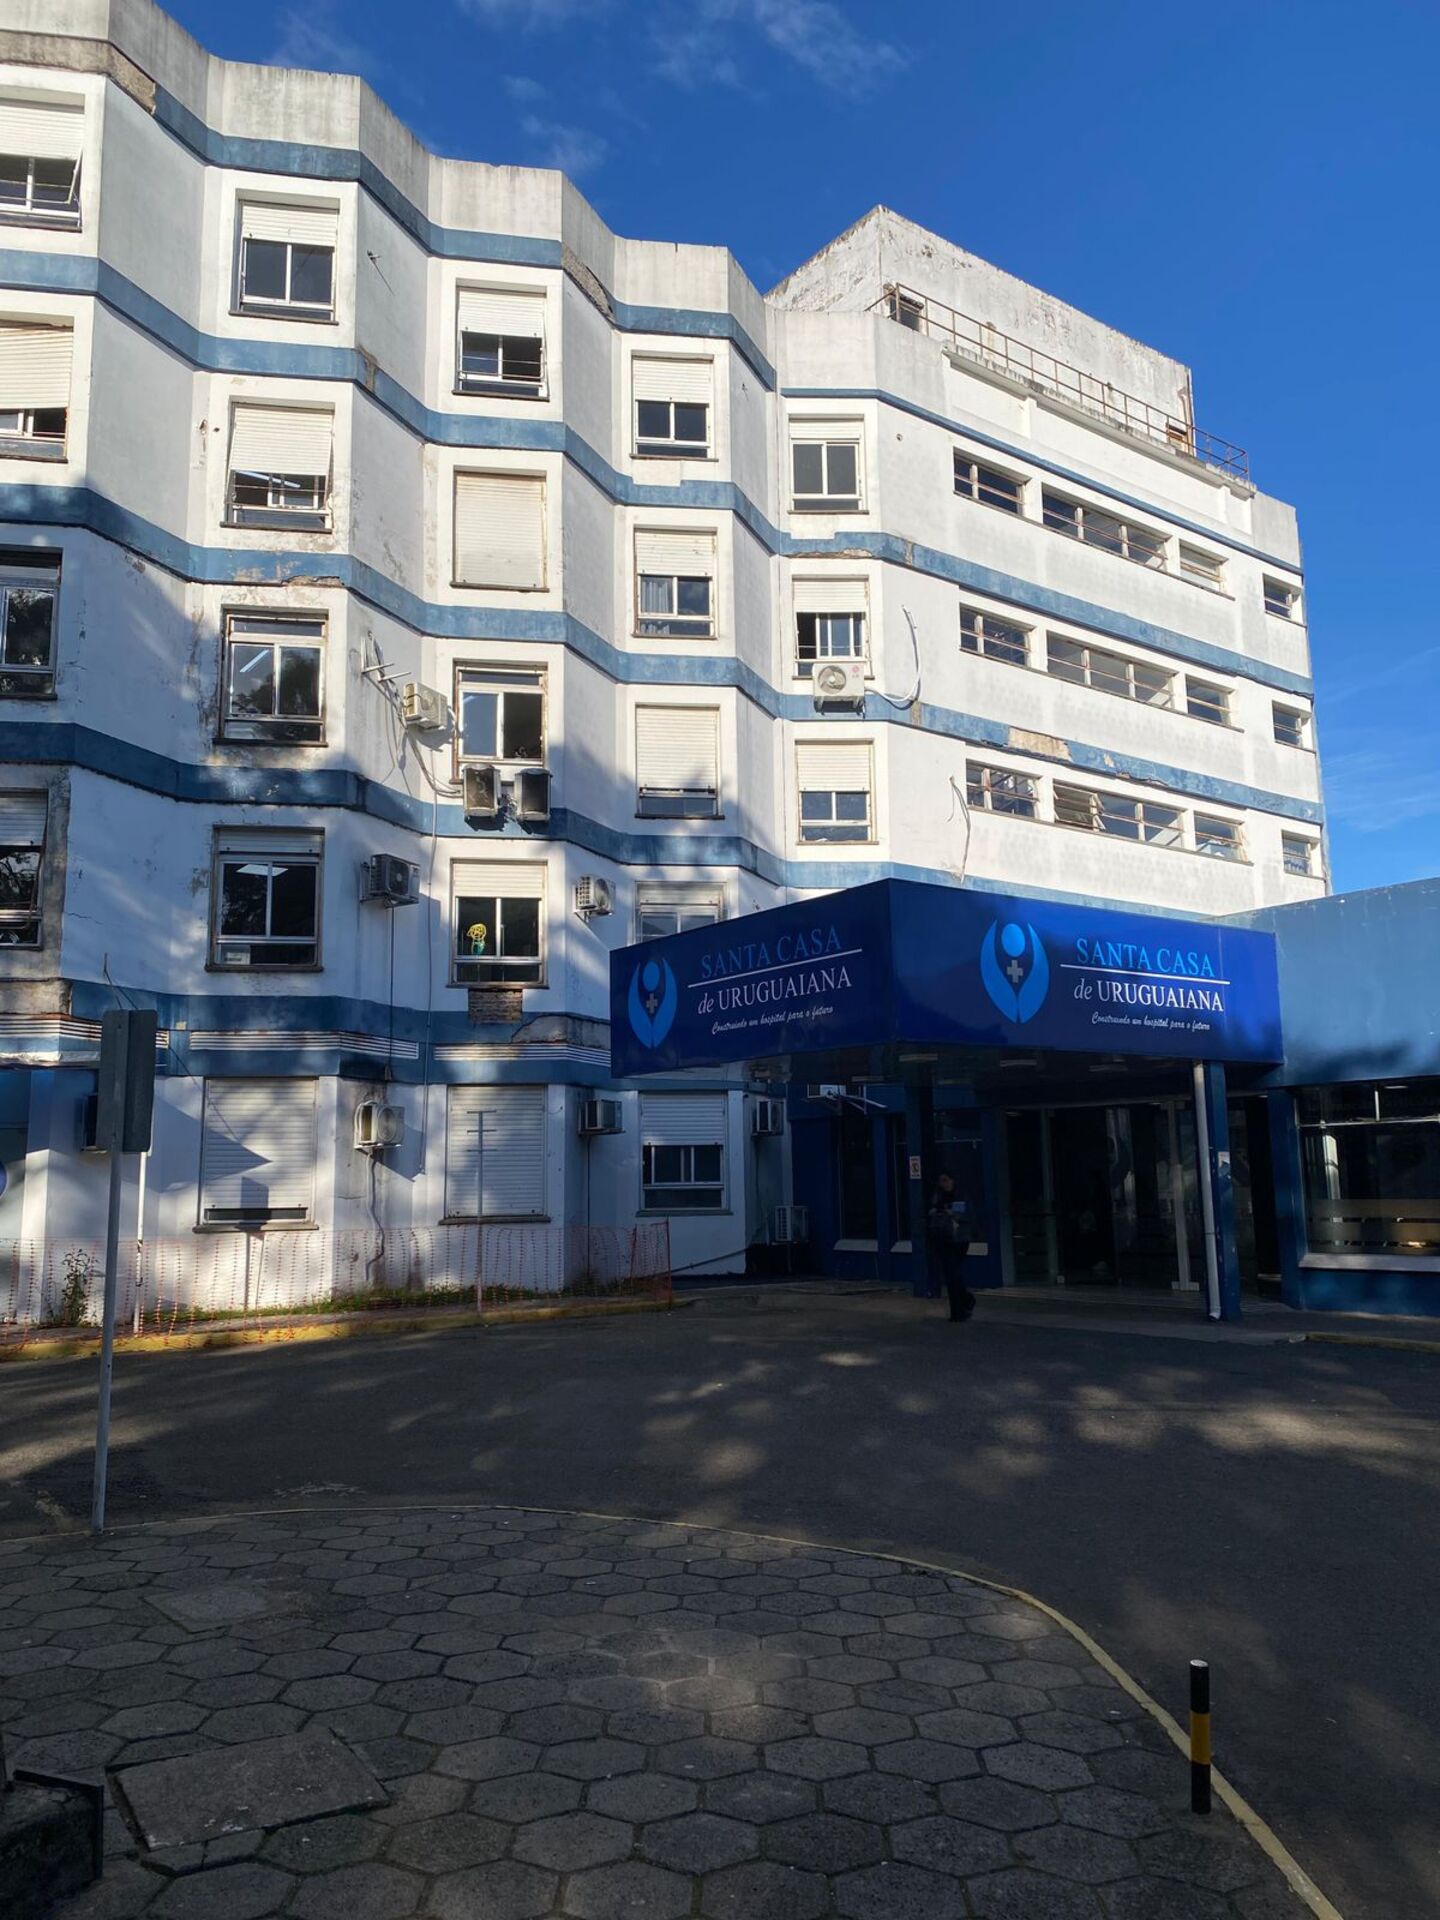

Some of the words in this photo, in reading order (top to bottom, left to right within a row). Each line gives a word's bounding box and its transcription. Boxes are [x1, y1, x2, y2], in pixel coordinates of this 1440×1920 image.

[701, 942, 773, 979] SANTA
[777, 925, 842, 962] CASA
[1076, 938, 1152, 972] SANTA
[1156, 948, 1215, 977] CASA
[698, 992, 714, 1014] de
[718, 965, 851, 1010] URUGUAIANA
[1073, 978, 1092, 1000] de
[1097, 980, 1224, 1012] URUGUAIANA
[760, 1011, 786, 1026] hospital
[787, 1010, 803, 1022] para
[812, 1006, 833, 1020] futuro
[1144, 1015, 1169, 1029] hospital
[1169, 1020, 1185, 1030] para
[1192, 1020, 1210, 1032] futuro
